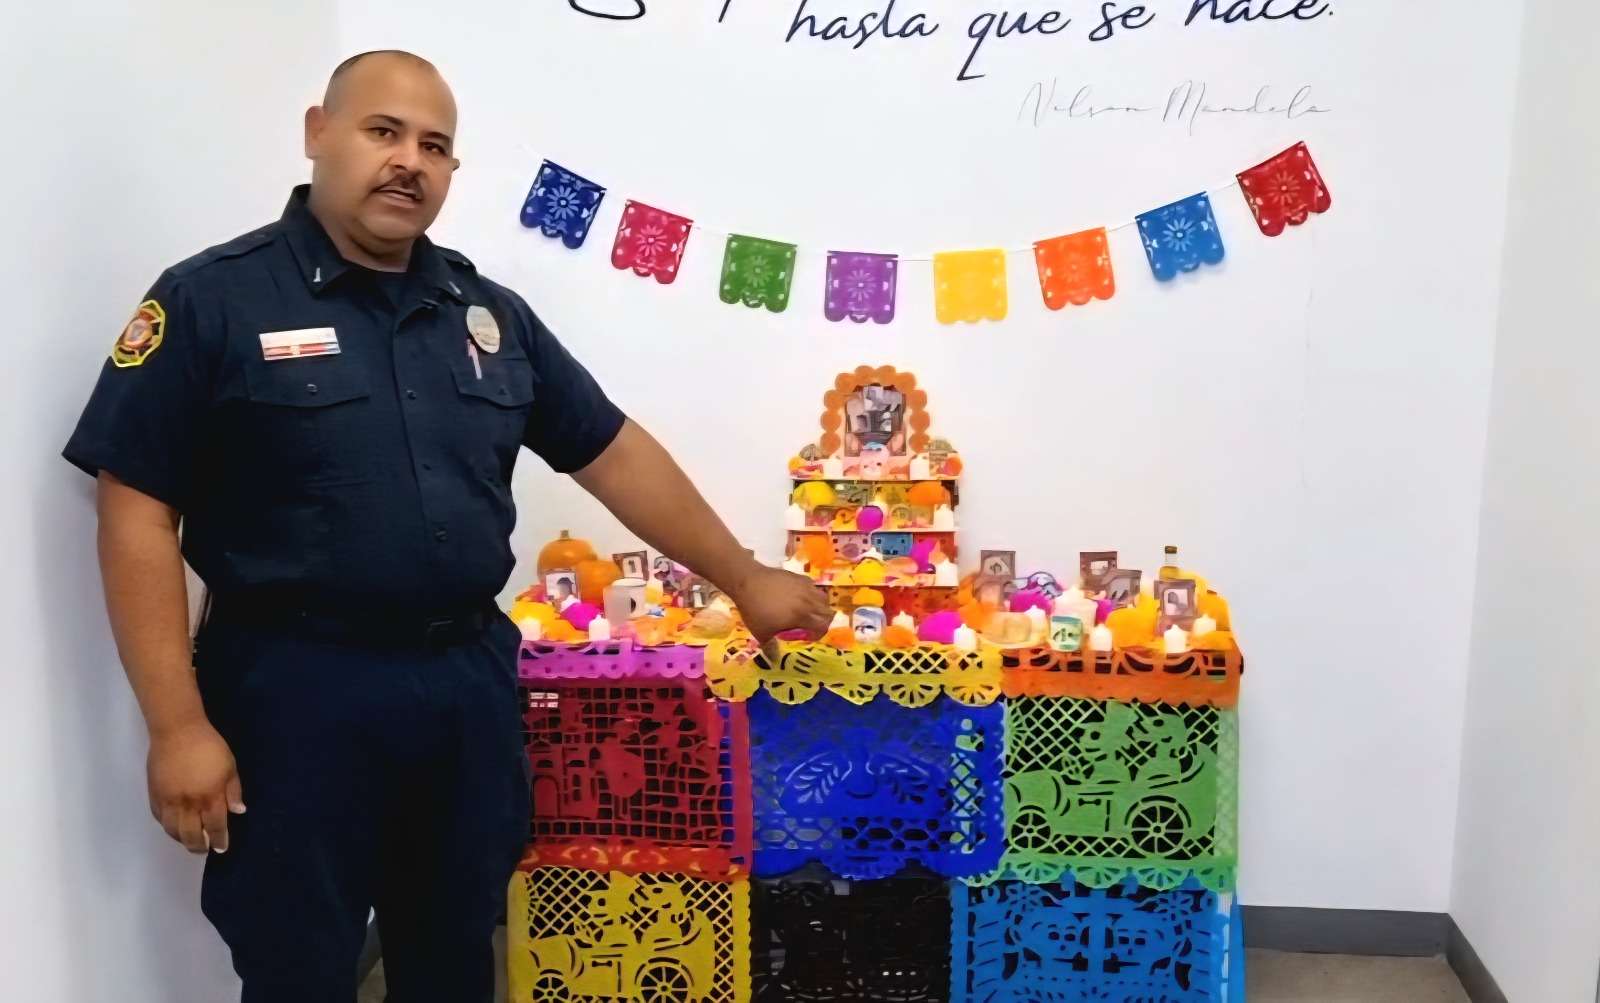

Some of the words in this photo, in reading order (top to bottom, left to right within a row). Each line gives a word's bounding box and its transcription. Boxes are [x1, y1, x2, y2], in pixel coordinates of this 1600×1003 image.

[956, 10, 1072, 82] que
[1088, 1, 1156, 42] se
[1017, 77, 1153, 127] Nelson
[1162, 80, 1332, 137] Mandela
